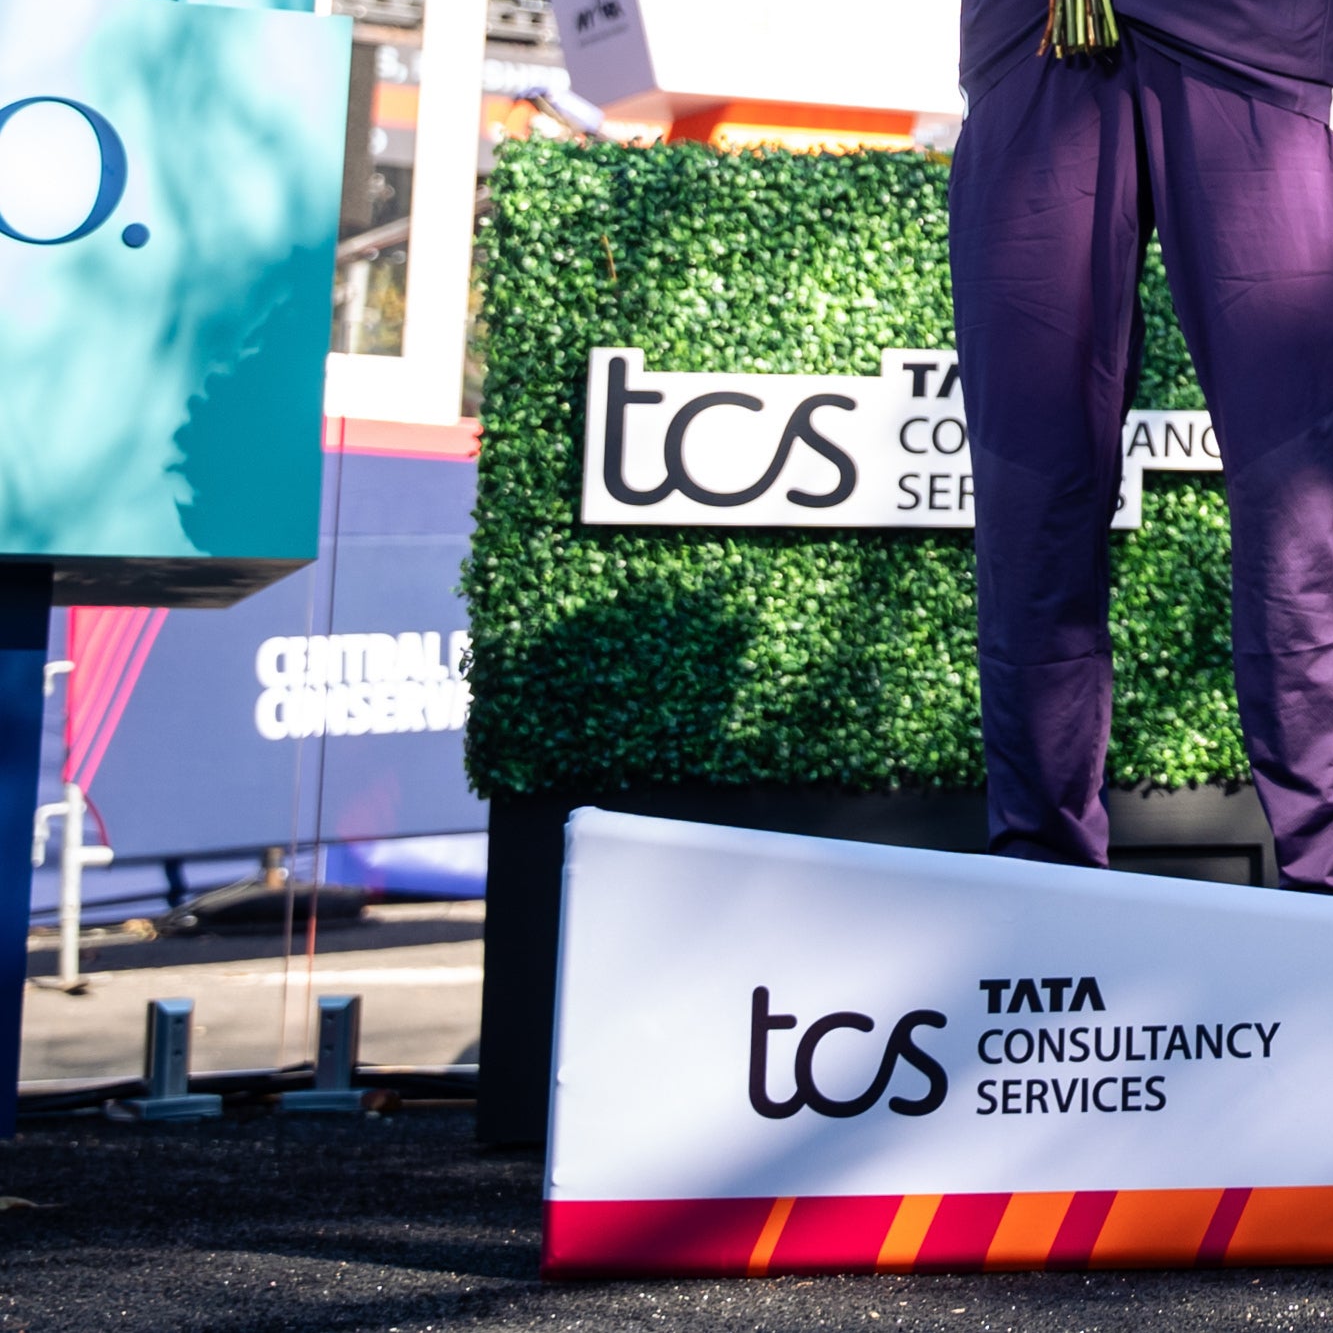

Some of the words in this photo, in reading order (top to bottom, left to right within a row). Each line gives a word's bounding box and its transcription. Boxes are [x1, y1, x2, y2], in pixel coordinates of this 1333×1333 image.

[604, 356, 858, 509] tcs
[979, 976, 1106, 1014] TATA
[748, 985, 949, 1120] tcs
[977, 1022, 1282, 1064] CONSULTANCY
[976, 1075, 1167, 1115] SERVICES
